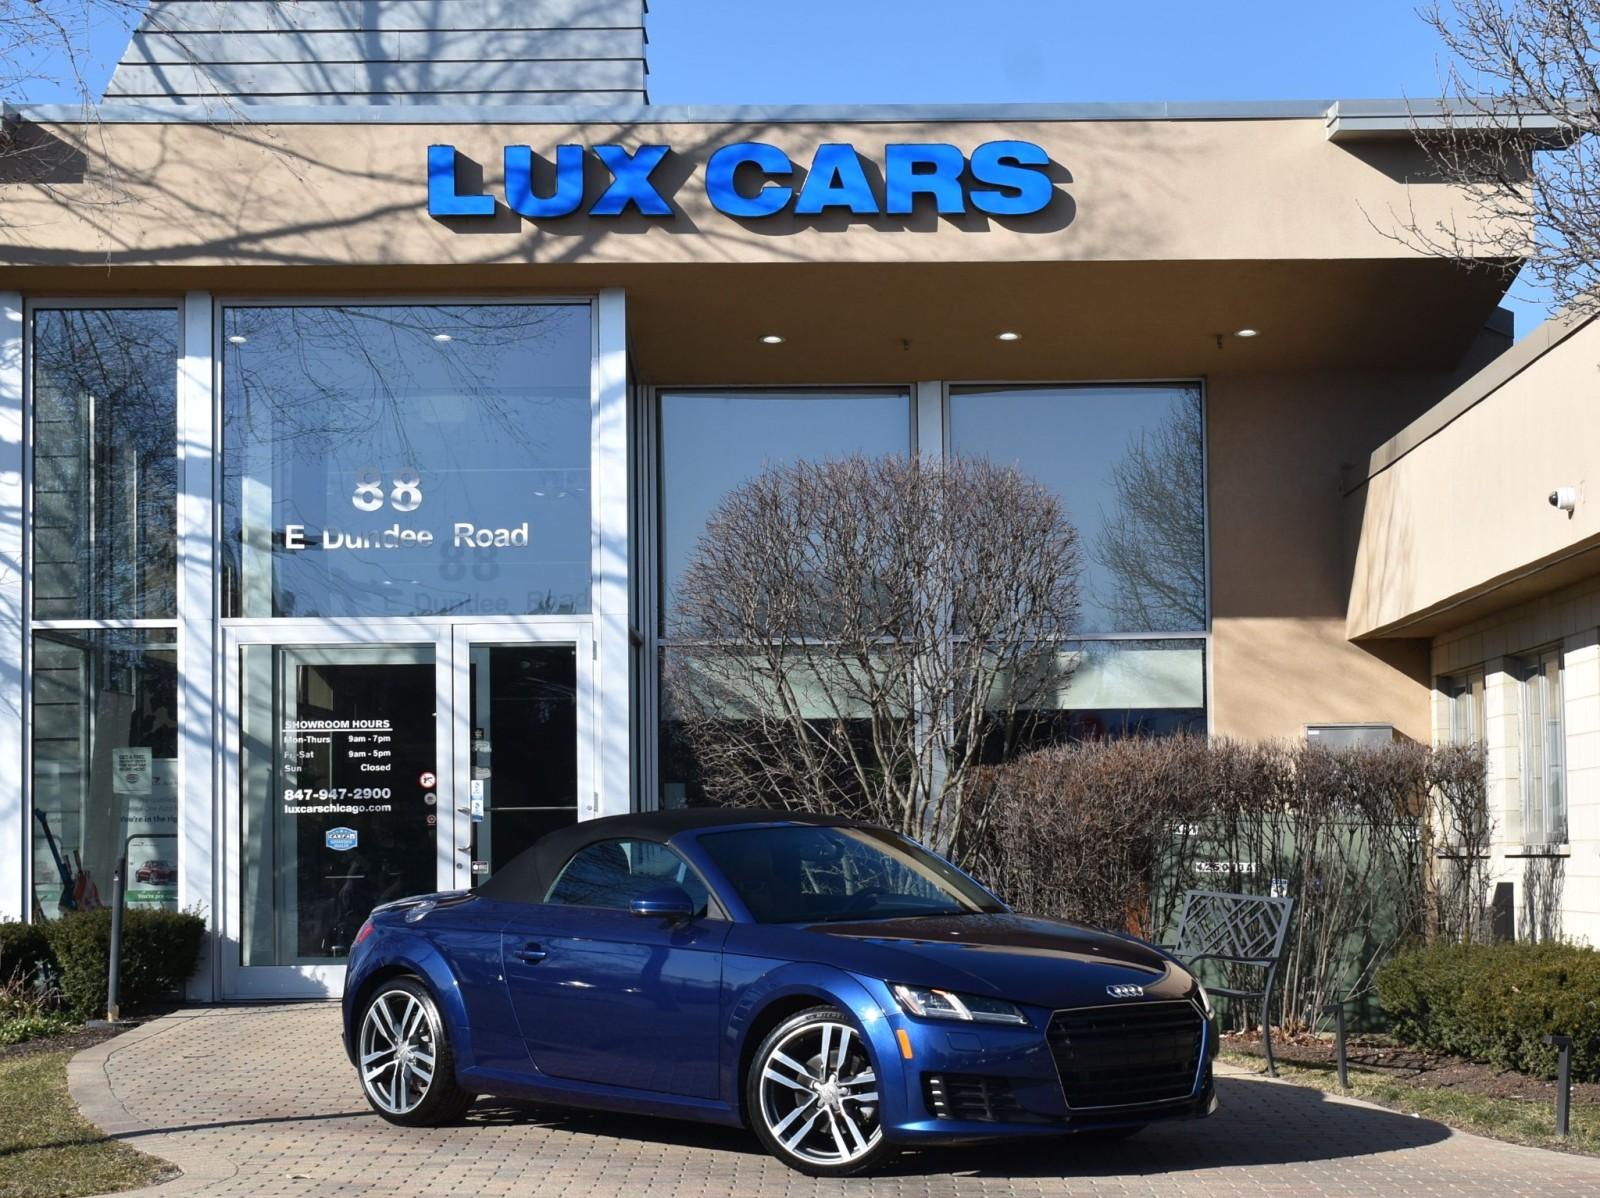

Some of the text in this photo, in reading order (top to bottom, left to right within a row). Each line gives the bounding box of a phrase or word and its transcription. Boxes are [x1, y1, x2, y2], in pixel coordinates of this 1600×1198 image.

[427, 140, 1055, 219] LUX CARS
[352, 466, 423, 512] 88
[285, 522, 529, 550] E Dundee Road
[285, 720, 390, 729] SHOWROOM HOURS
[284, 735, 331, 743] Mon-Thurs
[373, 735, 391, 744] 7pm
[373, 750, 391, 759] 5pm
[360, 764, 391, 772] Closed
[284, 788, 391, 801] 847-947-2900
[284, 804, 391, 814] luxcarschicago.com
